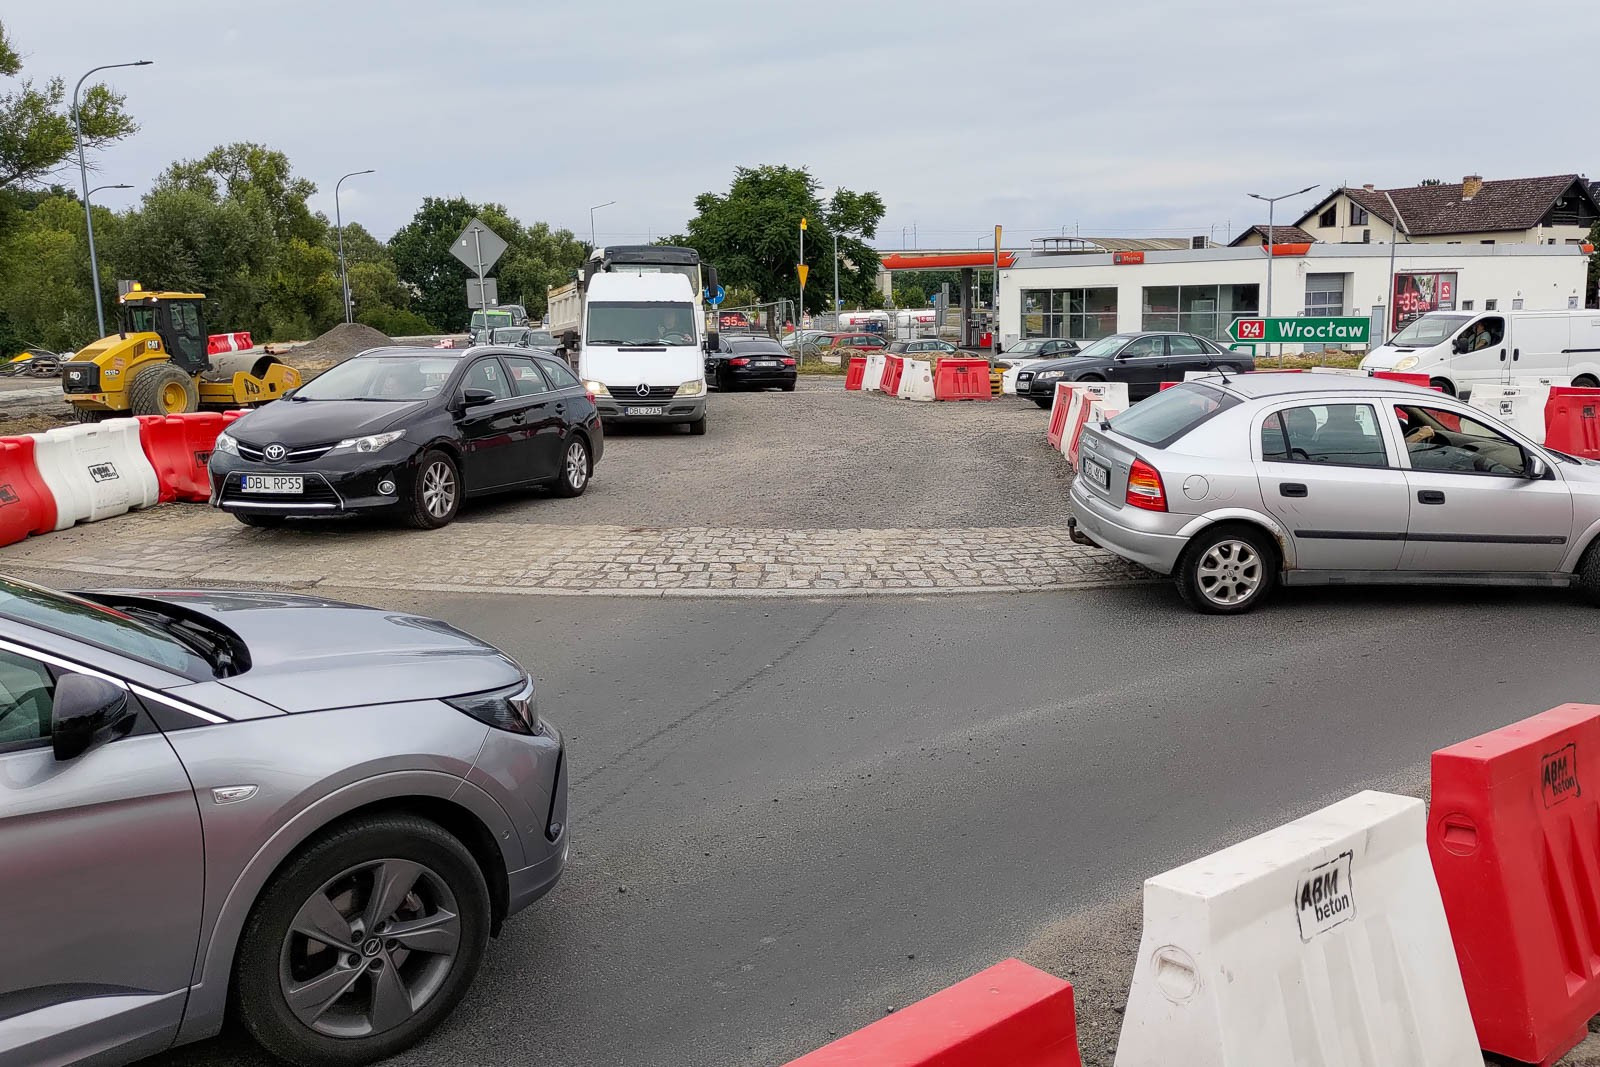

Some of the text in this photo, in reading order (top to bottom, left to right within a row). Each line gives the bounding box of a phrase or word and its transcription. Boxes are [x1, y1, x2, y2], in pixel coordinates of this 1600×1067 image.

[1398, 291, 1418, 311] -35
[720, 316, 738, 326] -35
[1242, 321, 1364, 337] 94 Wrocław
[147, 340, 159, 349] CAT
[247, 476, 270, 489] DBL
[273, 477, 302, 490] RP55
[1543, 754, 1568, 787] ABM
[1552, 776, 1575, 797] beton
[1301, 868, 1338, 911] ABM
[1315, 893, 1350, 922] beton
